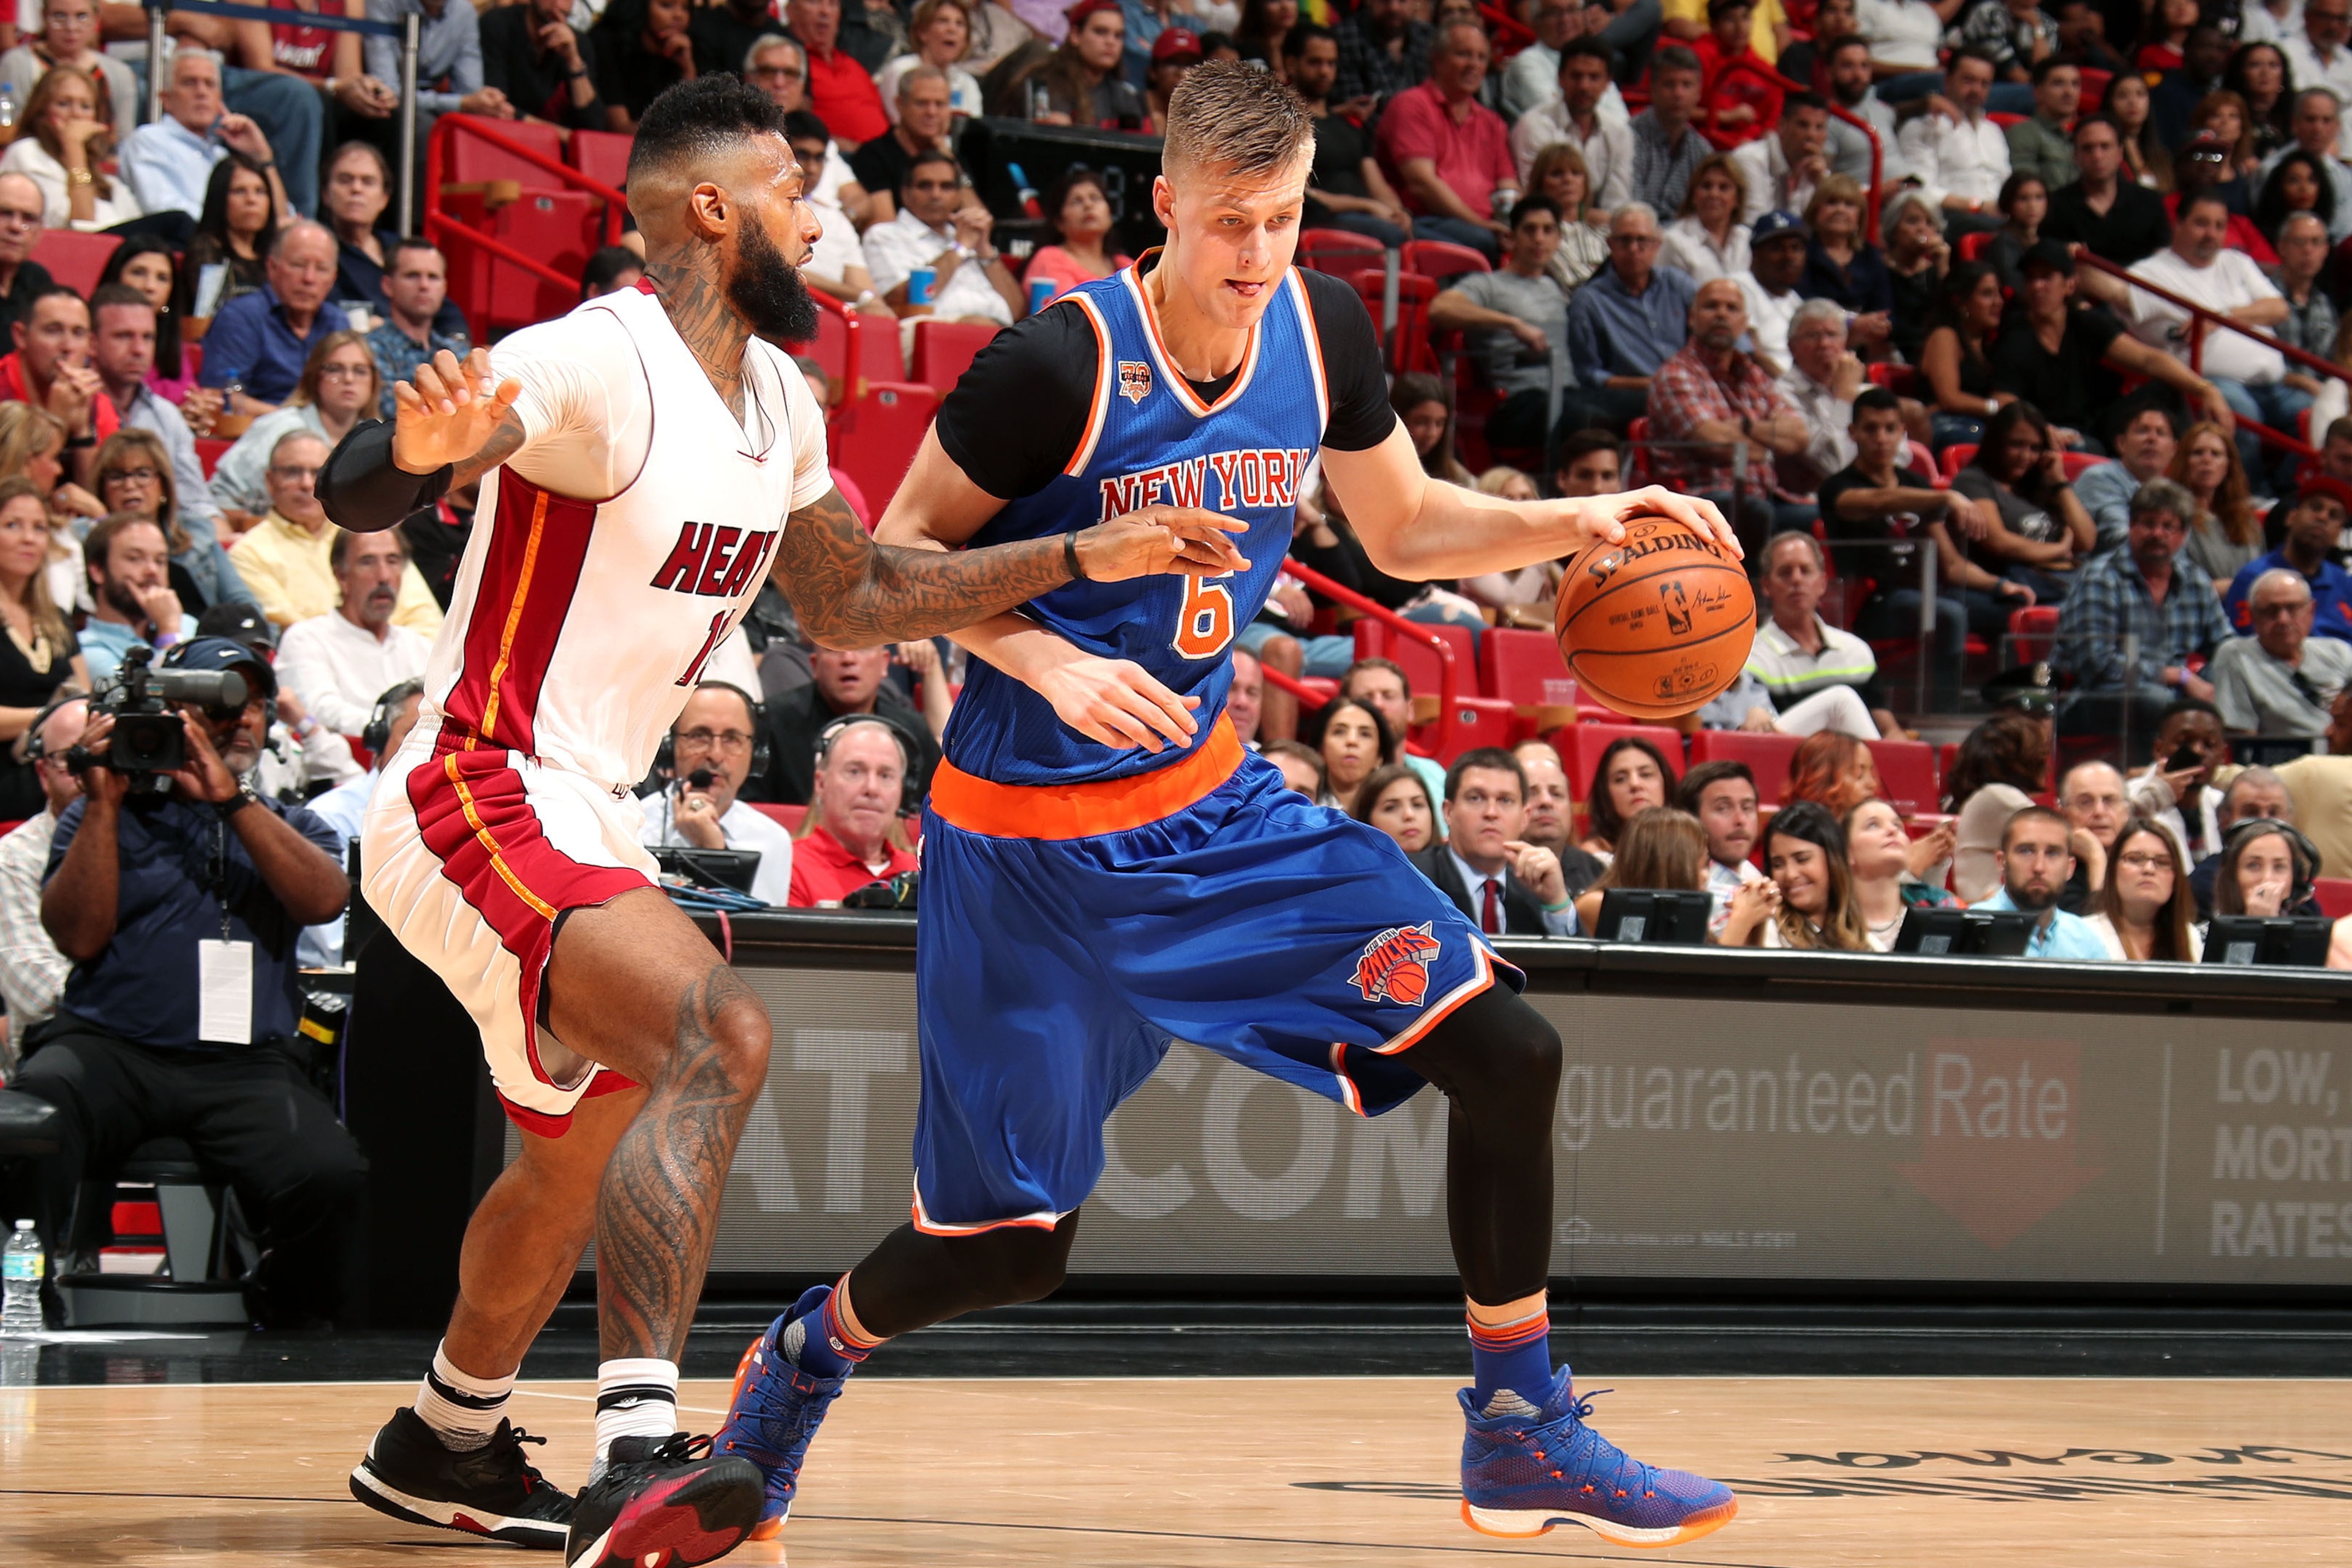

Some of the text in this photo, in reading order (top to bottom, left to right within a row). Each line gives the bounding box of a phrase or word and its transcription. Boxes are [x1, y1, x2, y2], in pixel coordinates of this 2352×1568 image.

[1099, 448, 1311, 524] NEW YORK
[1588, 533, 1722, 589] SPALDING
[1172, 569, 1236, 661] 6
[1359, 927, 1439, 999] KNICKS
[1366, 929, 1398, 956] NEW YORK
[1559, 1053, 2070, 1150] guaranteed Rate
[2217, 1047, 2339, 1117] LOW,
